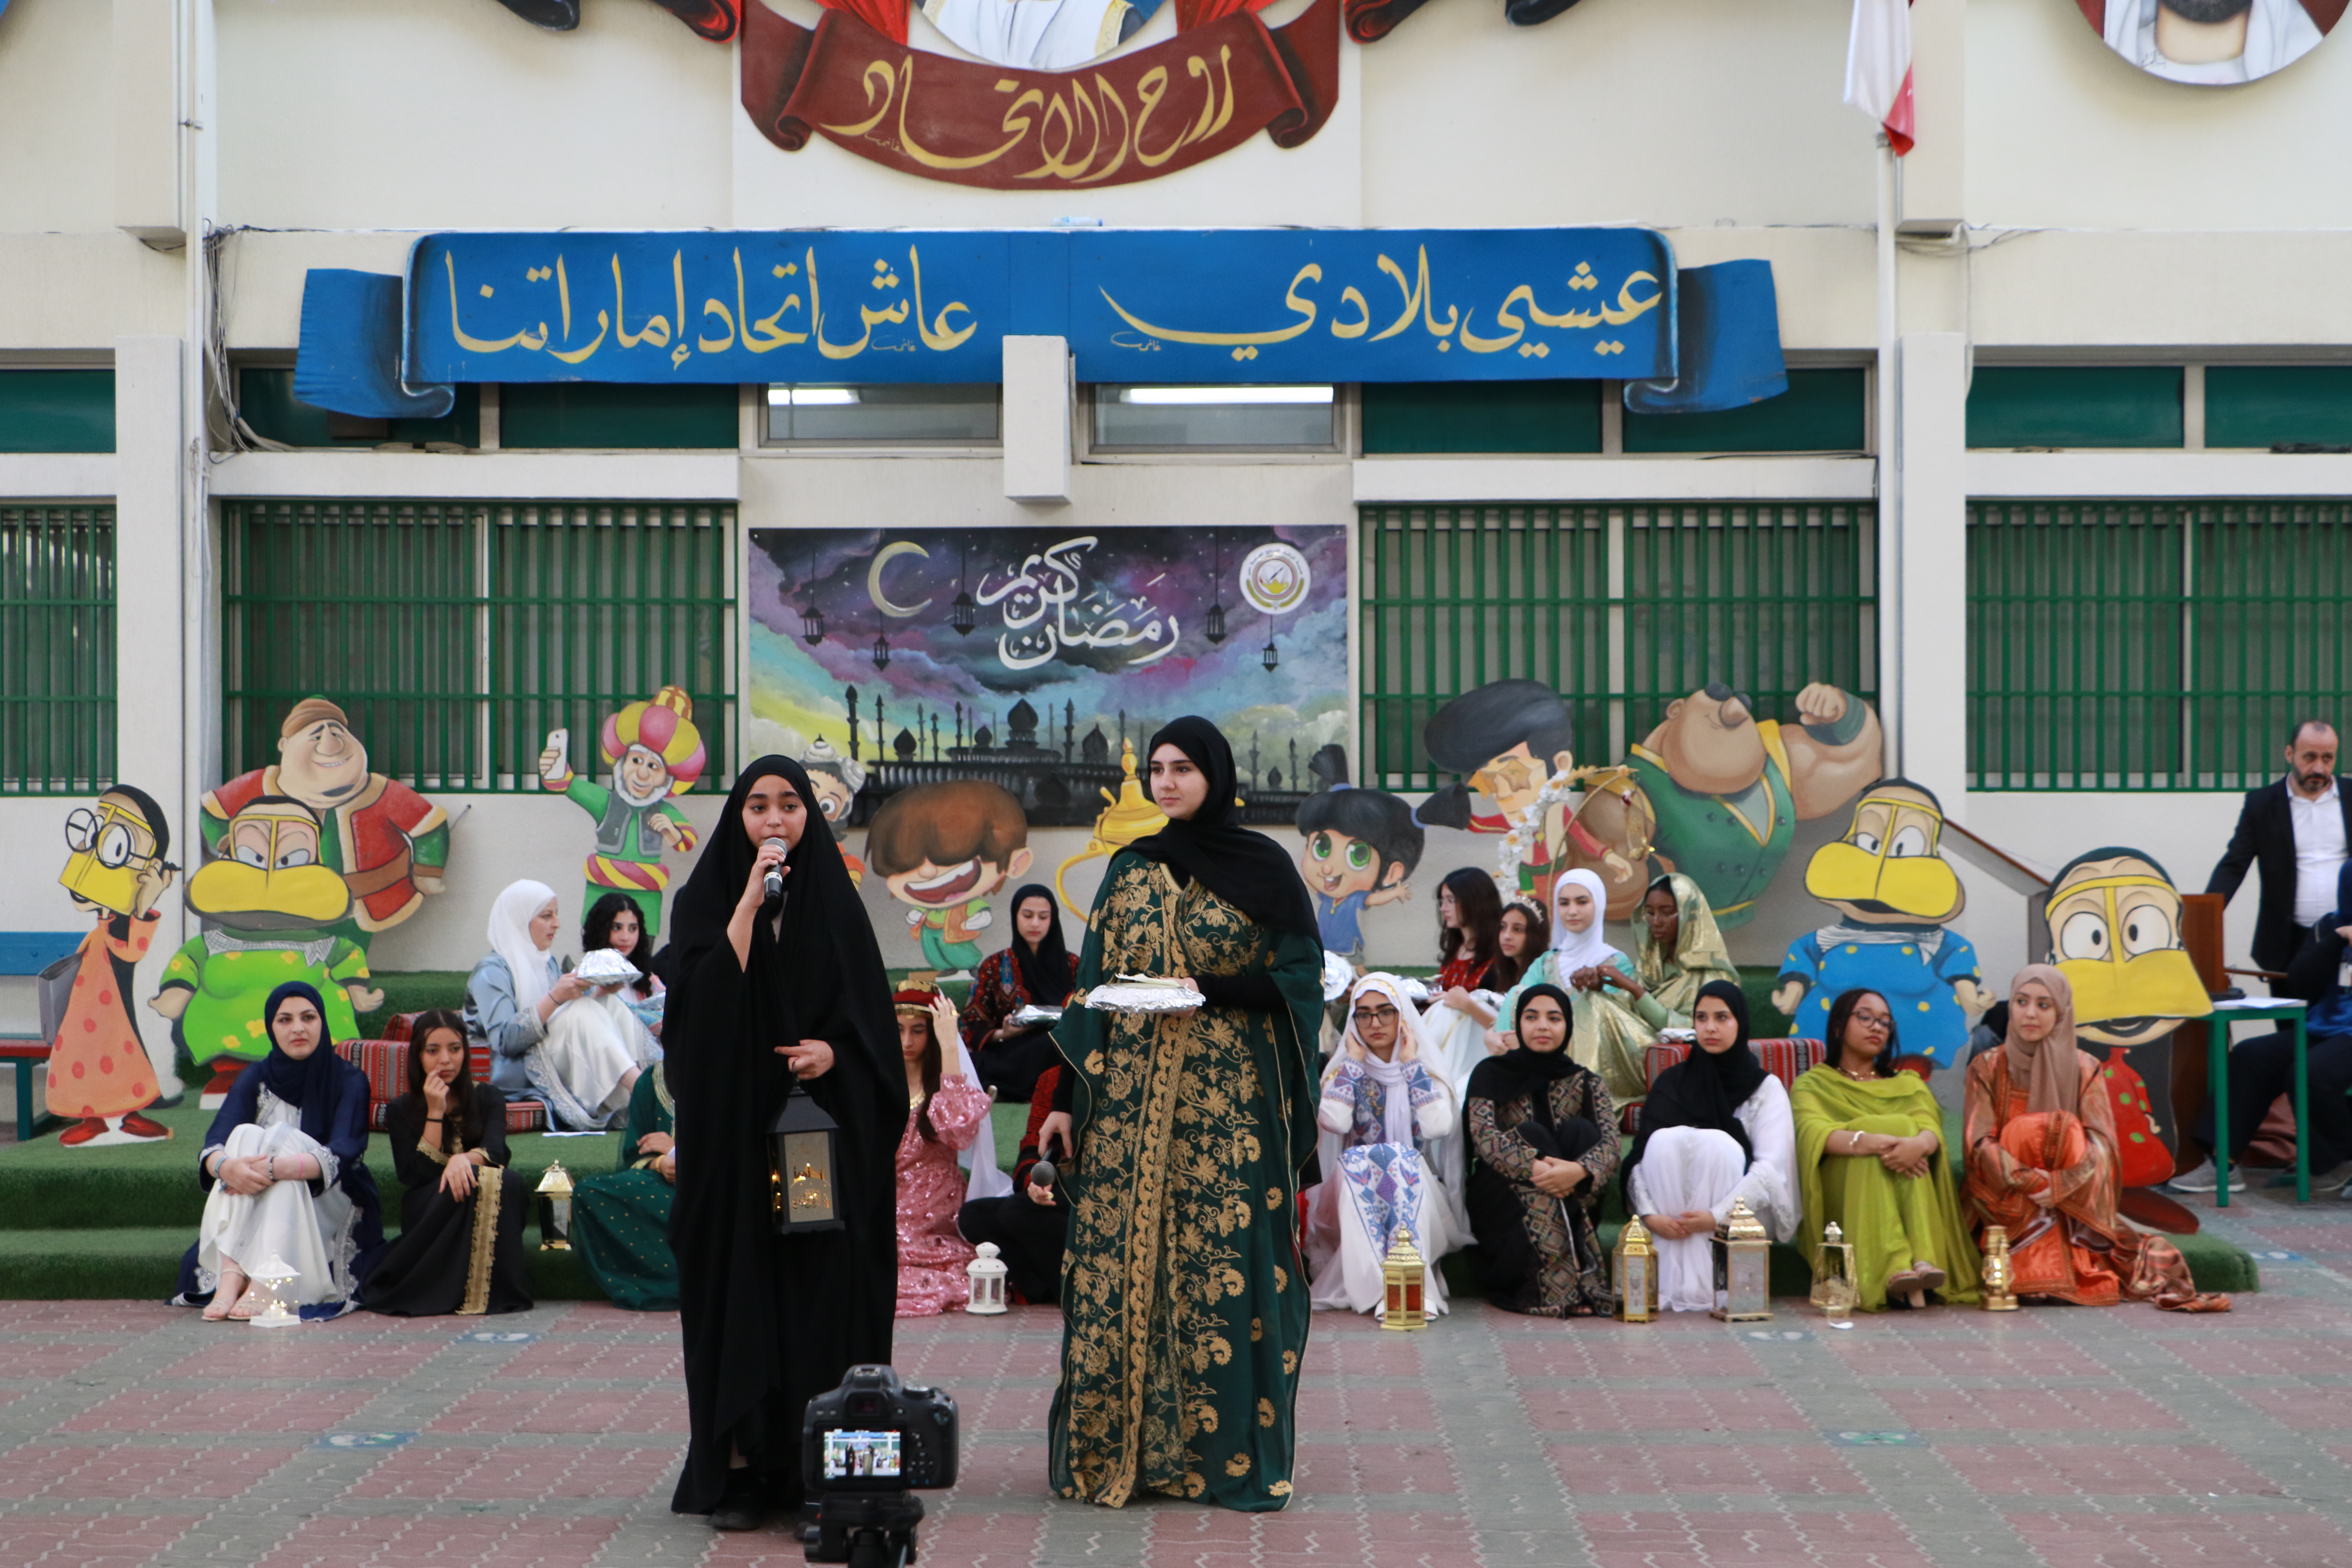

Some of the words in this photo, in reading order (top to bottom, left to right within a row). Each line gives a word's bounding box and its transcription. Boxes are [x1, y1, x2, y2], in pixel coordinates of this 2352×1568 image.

[1134, 45, 1233, 167] روح
[445, 249, 690, 371] إماراتنا
[698, 247, 819, 353] اتحاد
[818, 244, 977, 359] عاش
[1098, 244, 1458, 361] بلادي
[1461, 263, 1661, 358] عيشي
[976, 536, 1098, 629] كريم
[998, 574, 1180, 670] رمضان
